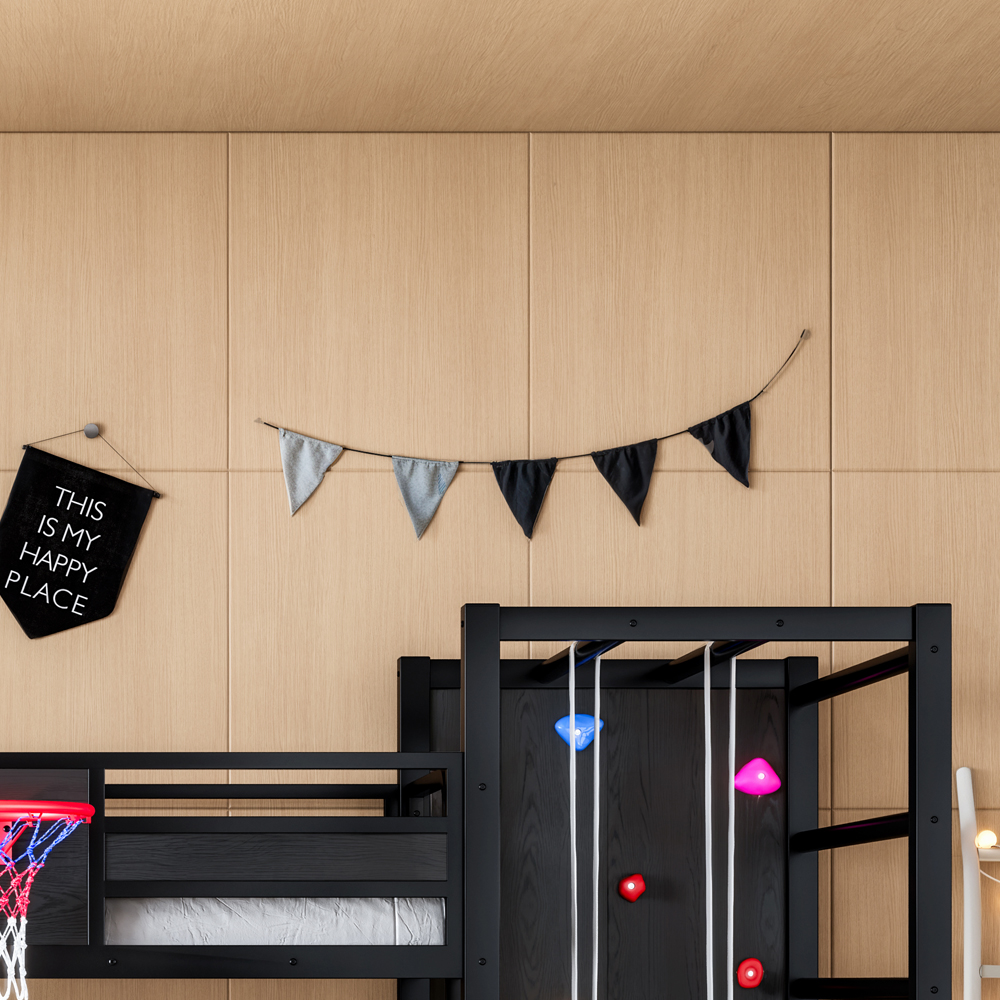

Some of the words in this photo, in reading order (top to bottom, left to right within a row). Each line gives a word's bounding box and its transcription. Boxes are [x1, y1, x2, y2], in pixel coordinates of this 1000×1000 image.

[56, 485, 107, 521] THIS
[37, 514, 58, 537] IS
[61, 523, 101, 551] MY
[19, 541, 98, 583] HAPPY
[4, 569, 89, 616] PLACE
